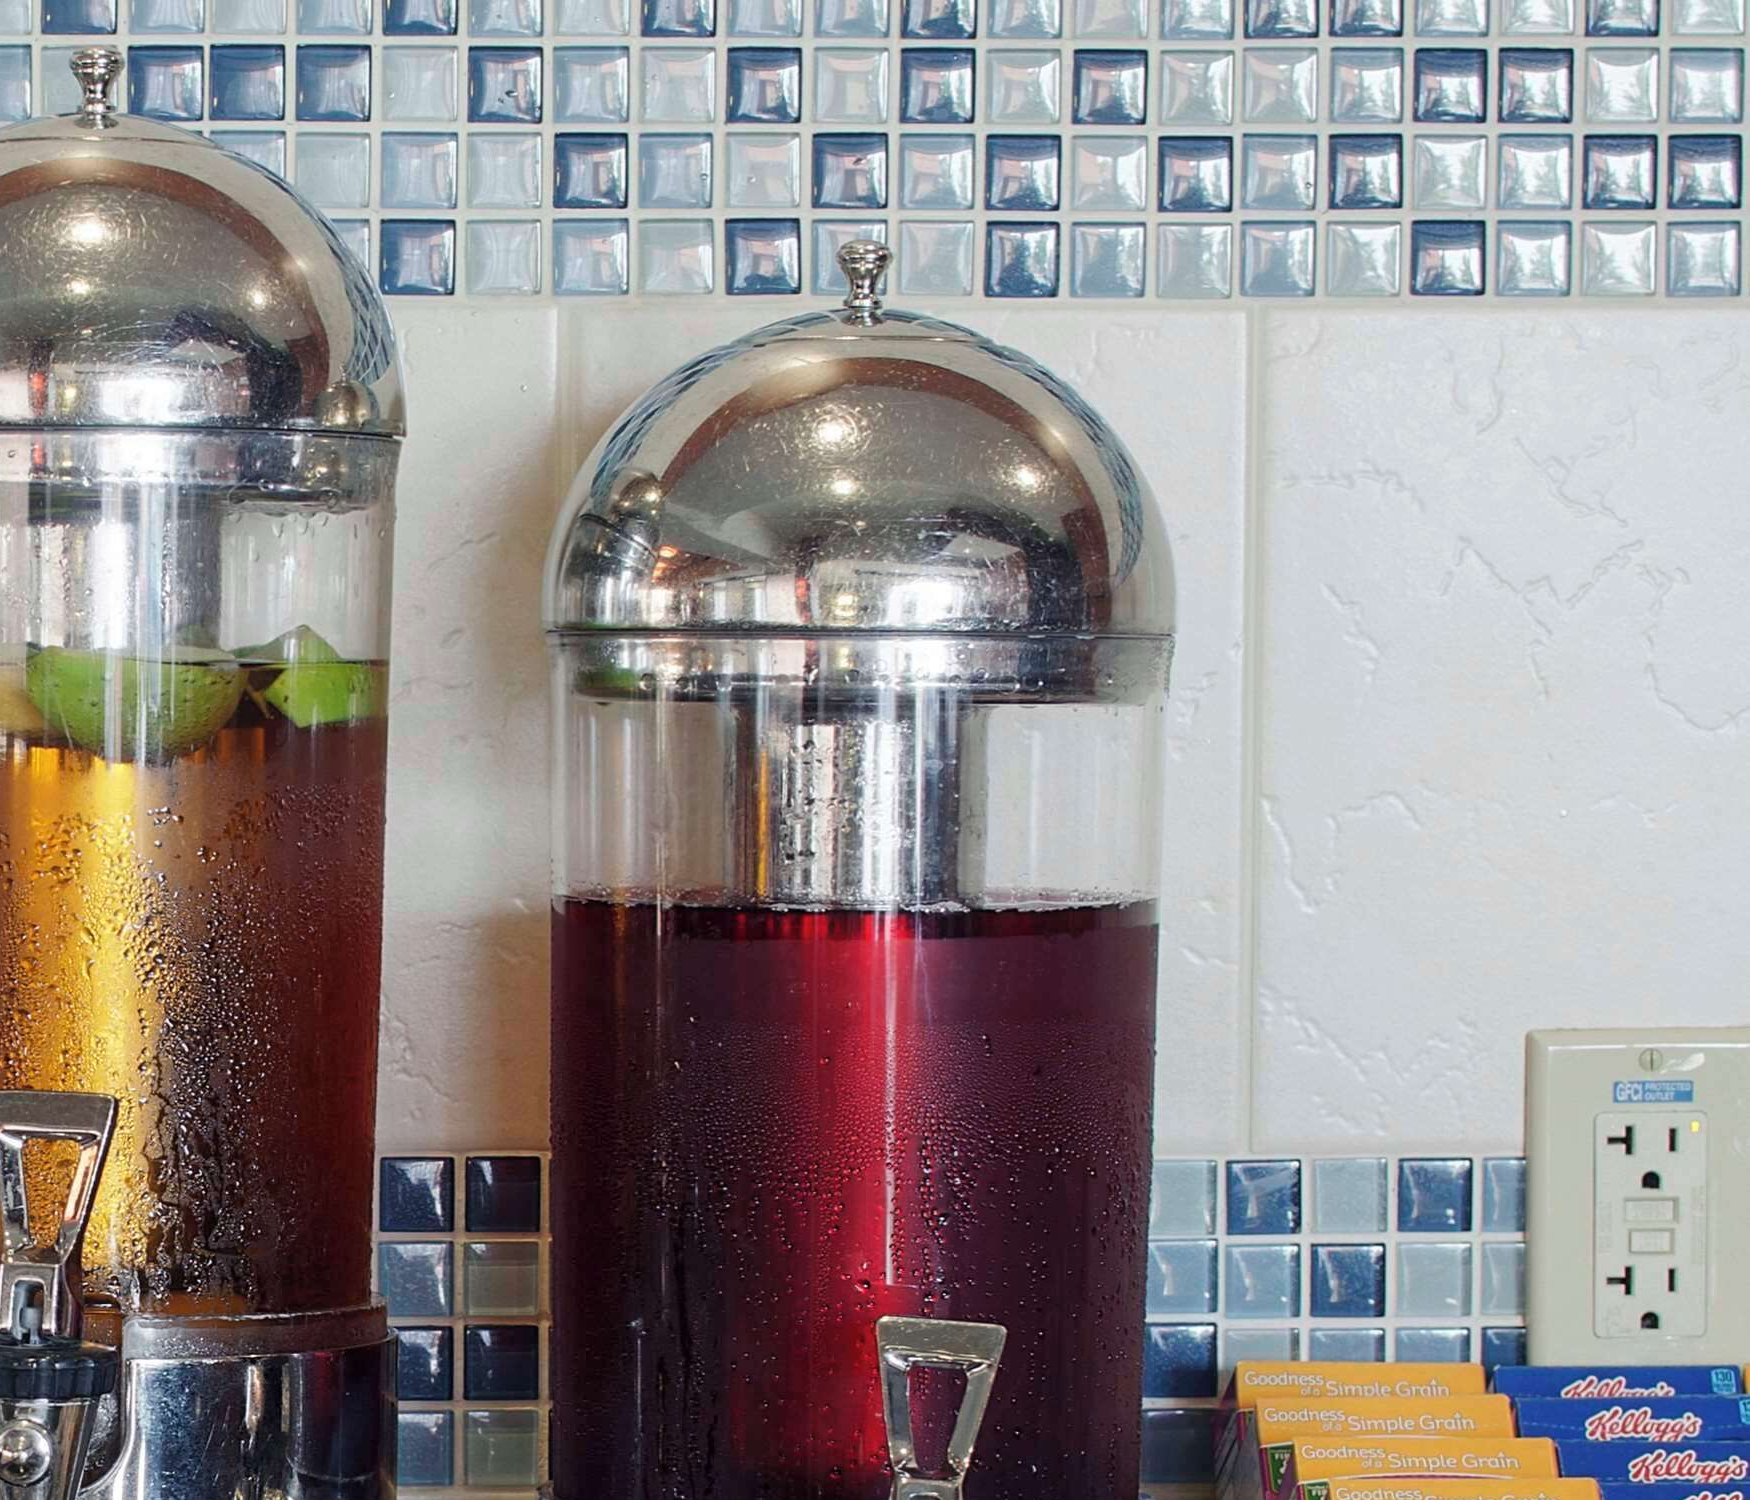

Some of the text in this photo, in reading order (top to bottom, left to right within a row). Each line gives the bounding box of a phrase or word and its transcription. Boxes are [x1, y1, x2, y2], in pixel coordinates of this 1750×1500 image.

[1617, 1083, 1642, 1101] GFCI
[1644, 1092, 1674, 1101] OUTLET
[1244, 1371, 1323, 1386] Goodness
[1326, 1381, 1391, 1397] Simple
[1395, 1380, 1450, 1397] Grain
[1264, 1408, 1345, 1422] Goodness
[1347, 1416, 1414, 1433] Simple
[1419, 1412, 1475, 1430] Grain
[1587, 1407, 1702, 1441] Kellogg's
[1301, 1445, 1386, 1459] Goodness
[1388, 1453, 1457, 1471] Simple
[1462, 1451, 1519, 1469] Grain
[1630, 1450, 1748, 1483] Kellogg's
[1336, 1487, 1422, 1500] Goodness
